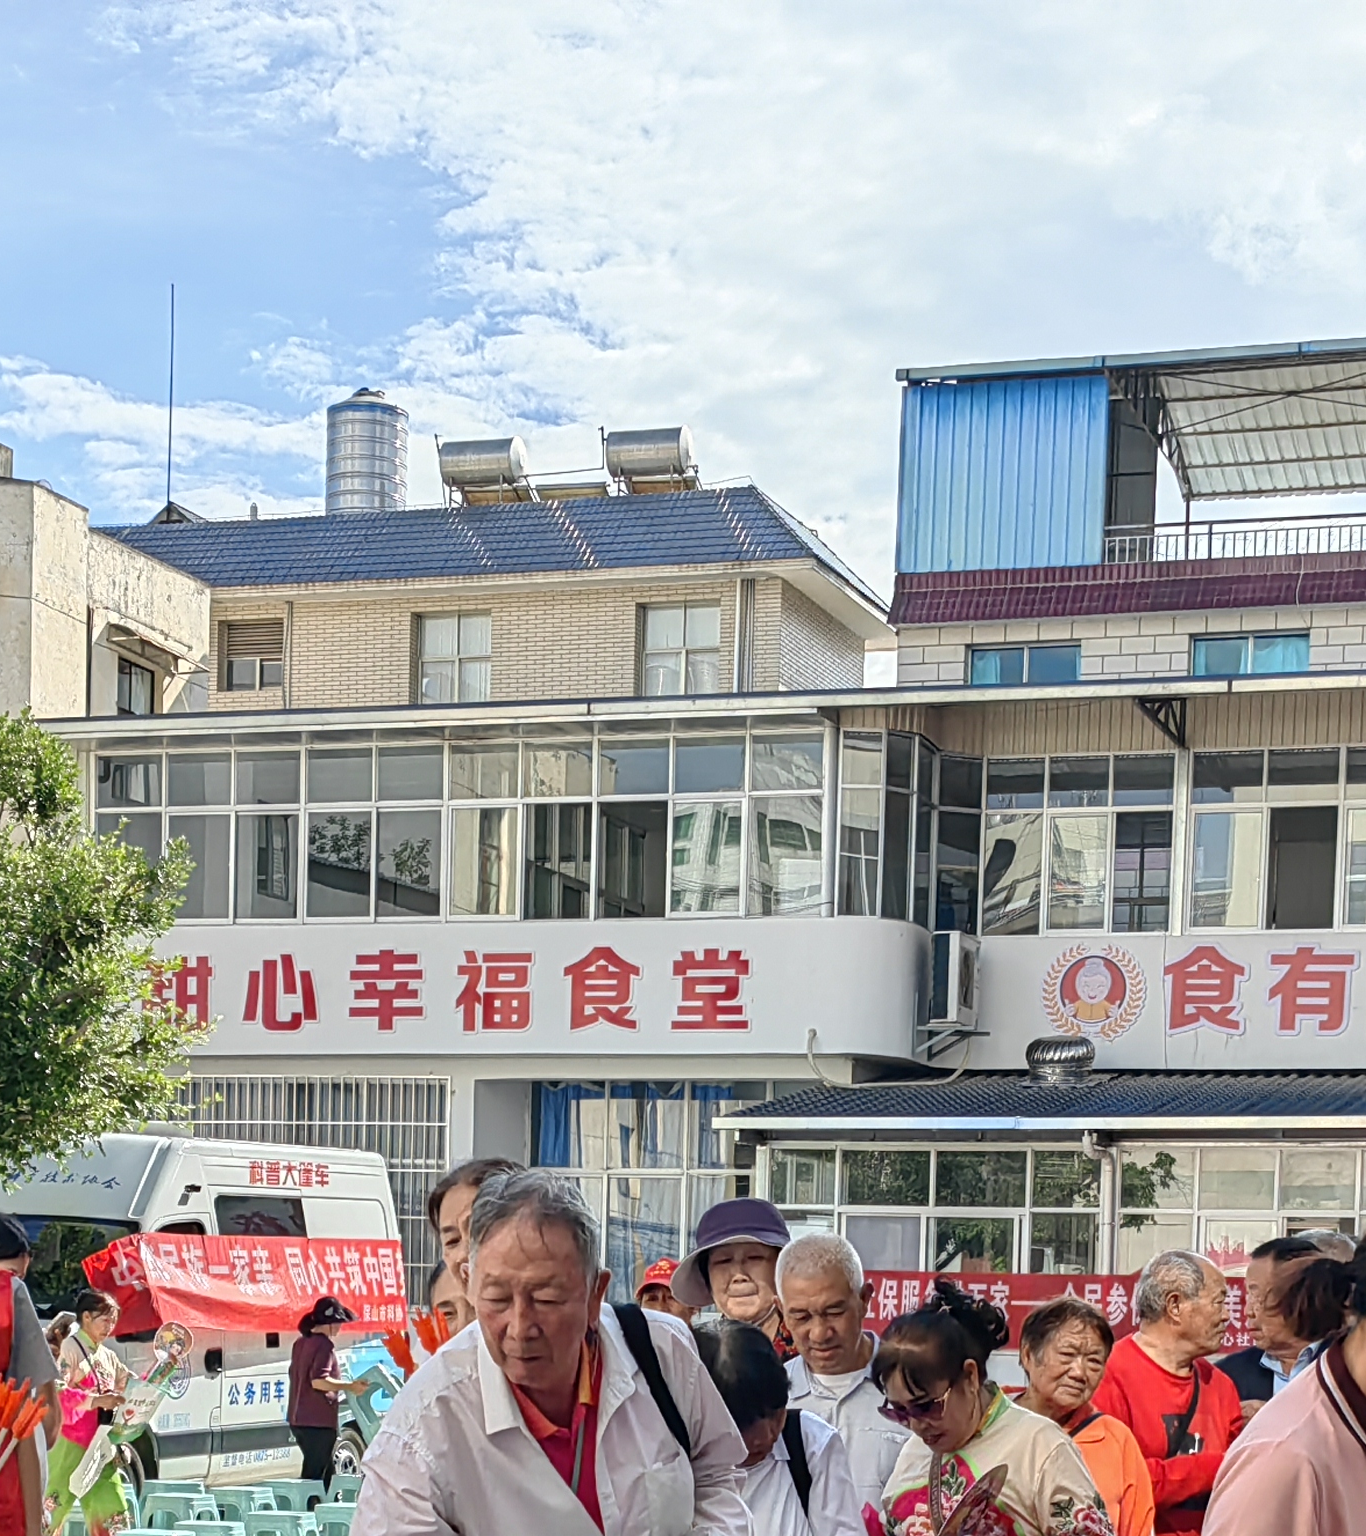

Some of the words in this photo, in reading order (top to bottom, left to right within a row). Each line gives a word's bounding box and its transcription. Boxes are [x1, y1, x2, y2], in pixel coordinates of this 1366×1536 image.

[143, 946, 753, 1034] 甜心幸福食堂
[248, 1160, 330, 1188] 科普大篷车
[228, 1380, 285, 1406] 公务用车
